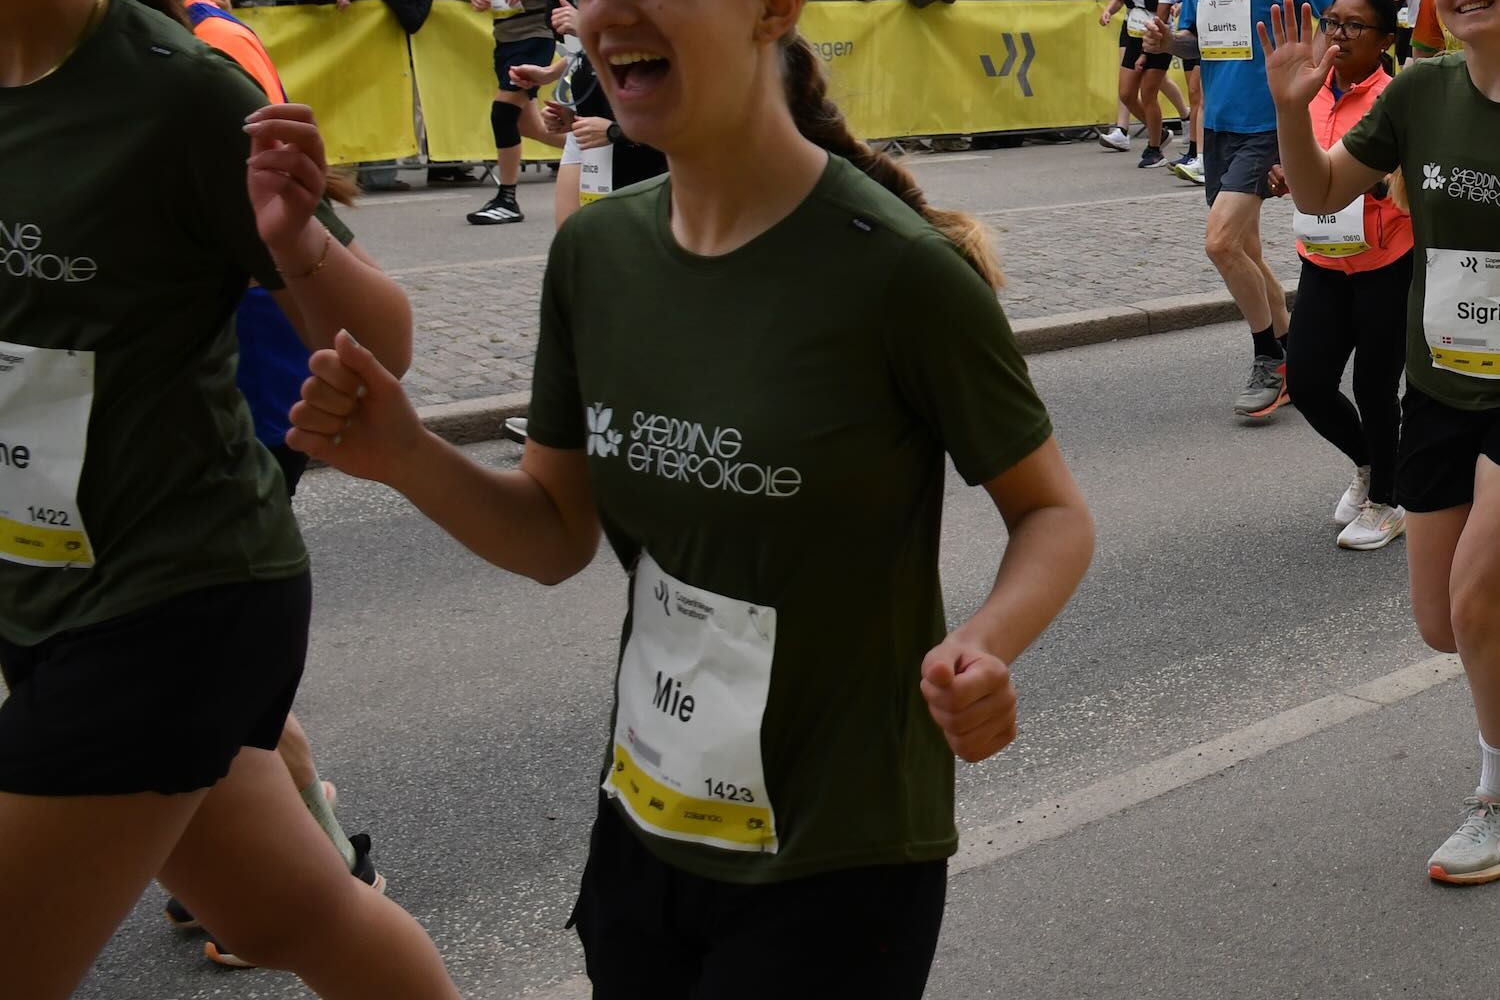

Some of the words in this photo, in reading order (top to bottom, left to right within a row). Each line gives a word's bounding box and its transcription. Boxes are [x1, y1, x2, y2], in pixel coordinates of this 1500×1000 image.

[1208, 23, 1237, 32] Laurits
[27, 505, 71, 526] 1422
[653, 670, 695, 722] Mie
[704, 777, 754, 803] 1423
